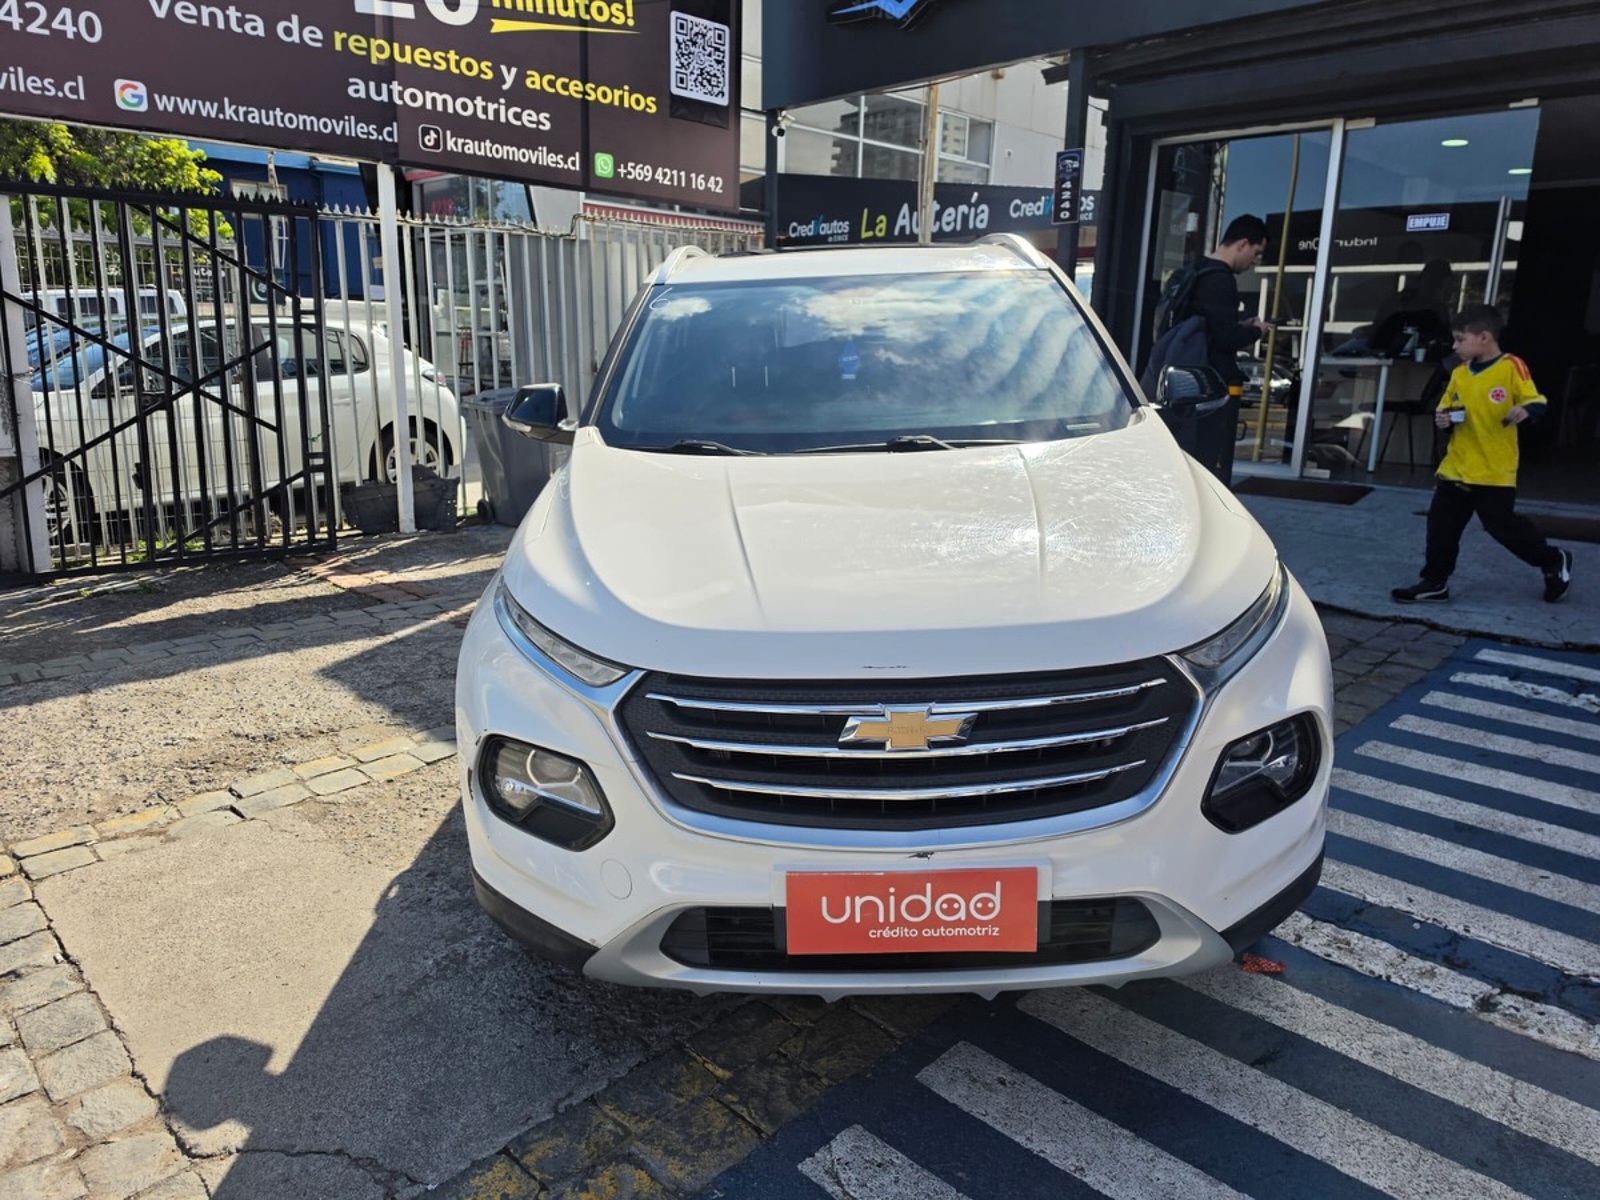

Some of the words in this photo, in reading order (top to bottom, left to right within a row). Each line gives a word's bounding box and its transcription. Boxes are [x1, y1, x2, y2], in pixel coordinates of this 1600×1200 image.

[0, 0, 103, 43] 4240
[149, 0, 266, 37] Venta
[276, 14, 324, 48] de
[333, 30, 494, 80] repuestos
[500, 64, 518, 90] y
[525, 70, 657, 114] accesorios
[153, 93, 398, 143] www.krautomoviles.cl
[347, 77, 552, 131] automotrices
[446, 130, 580, 171] krautomoviles.cl
[617, 162, 653, 182] +569
[654, 167, 686, 187] 4211
[690, 173, 706, 191] 16
[707, 176, 723, 193] 42
[861, 207, 887, 239] La
[894, 192, 989, 236] Autería
[1059, 181, 1073, 220] 4240
[821, 881, 1001, 924] unidad
[868, 926, 919, 938] crédito
[922, 925, 1000, 937] automotriz
